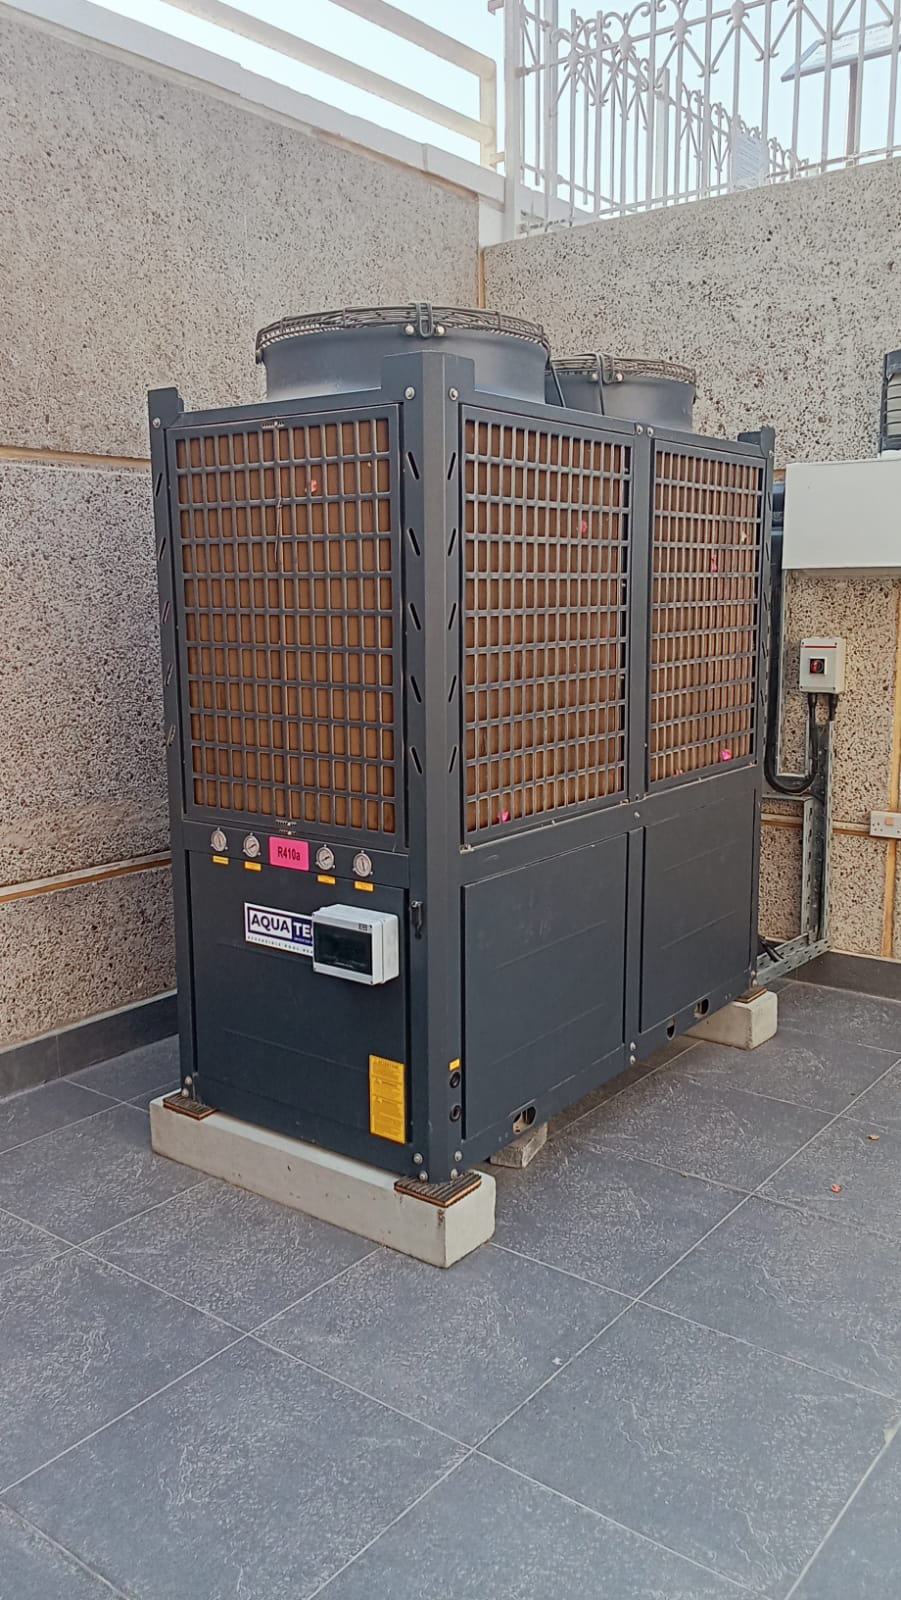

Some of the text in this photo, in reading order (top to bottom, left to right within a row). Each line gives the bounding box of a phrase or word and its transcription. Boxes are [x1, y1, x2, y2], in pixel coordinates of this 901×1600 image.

[277, 846, 300, 861] R410a
[251, 914, 313, 938] AQUA TE
